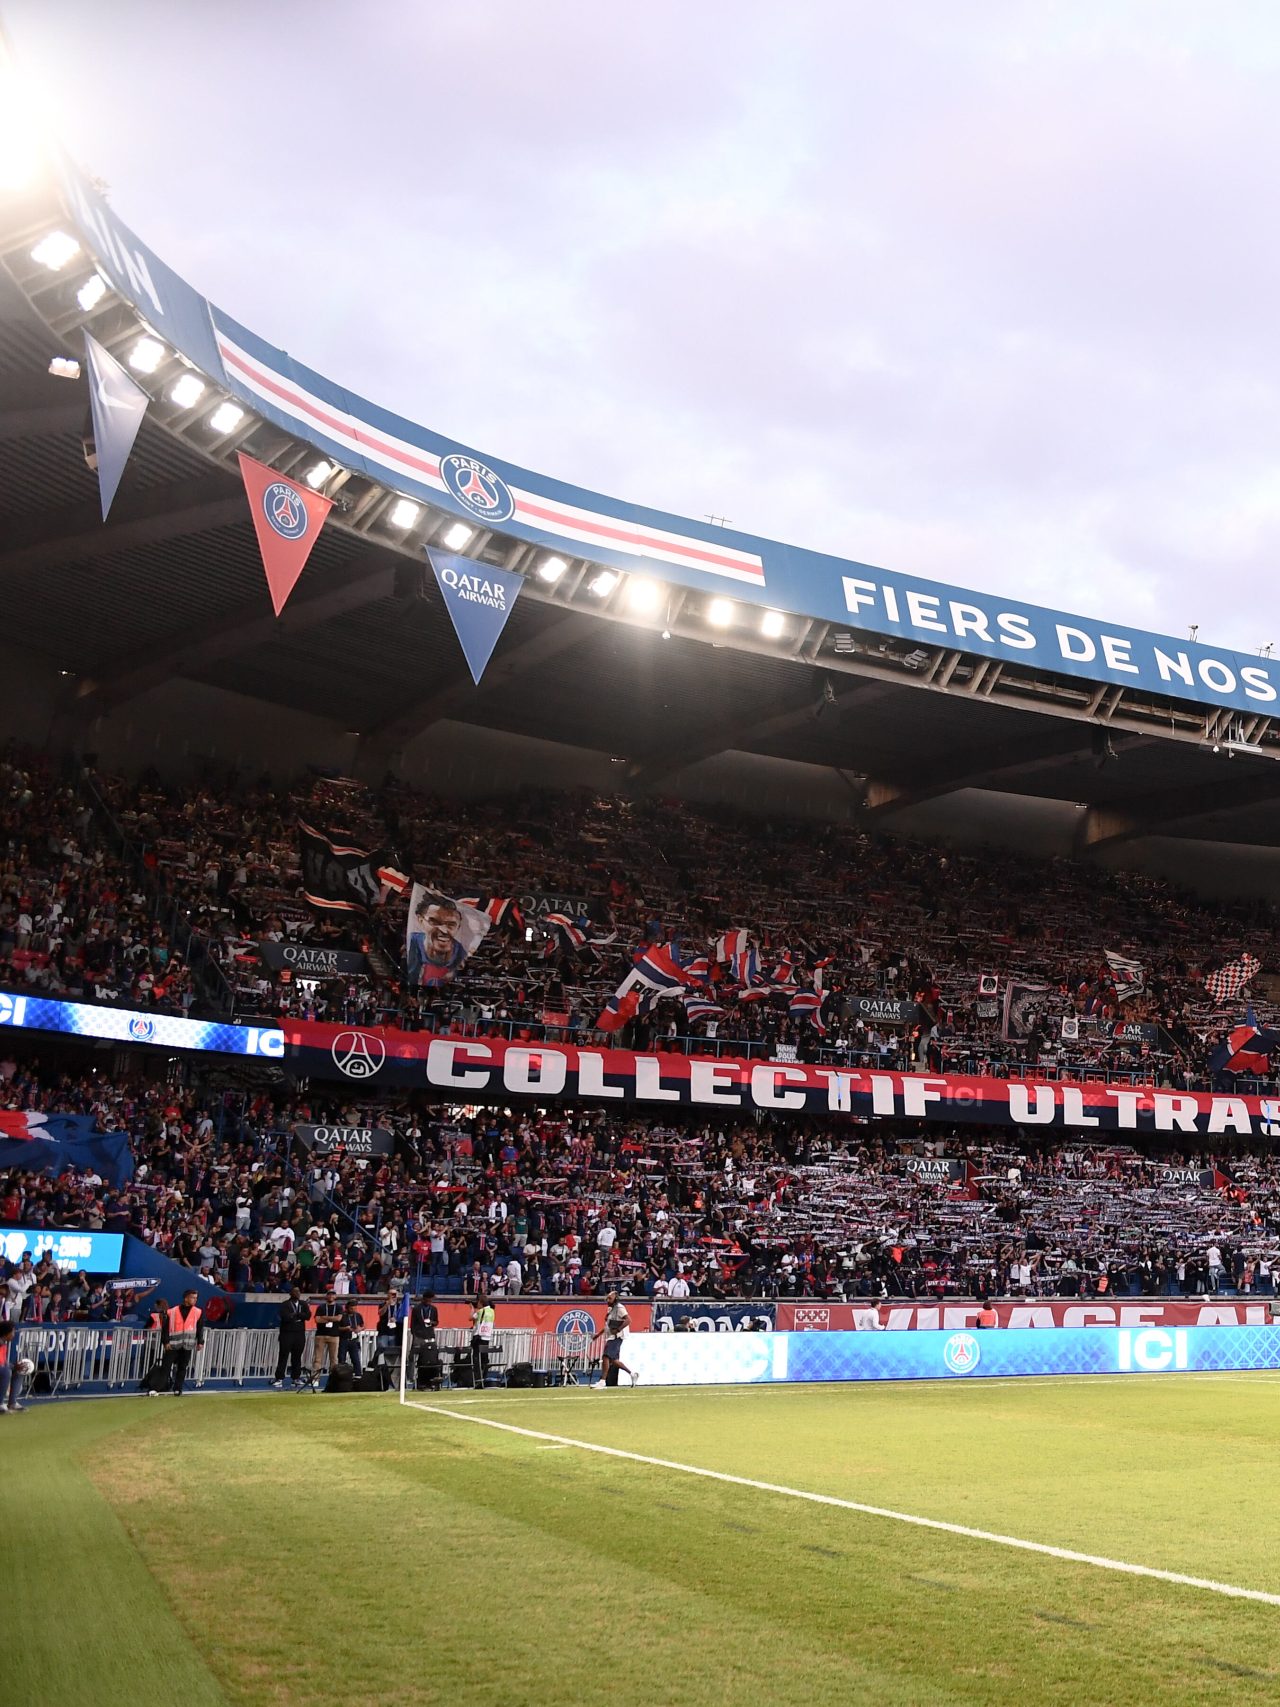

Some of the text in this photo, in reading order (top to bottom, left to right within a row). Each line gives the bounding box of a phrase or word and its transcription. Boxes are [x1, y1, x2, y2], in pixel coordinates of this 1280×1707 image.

[450, 457, 498, 485] PARIS
[272, 486, 301, 506] PARIS
[441, 568, 506, 601] QATAR
[458, 588, 506, 611] AIRWAYS
[841, 575, 1037, 650] FIERS
[1055, 623, 1139, 674] DE
[1153, 645, 1277, 702] NOS
[519, 895, 589, 916] QATAR
[283, 947, 338, 966] QATAR
[860, 999, 901, 1013] QATAR
[870, 1011, 901, 1020] AIRWAYS
[426, 1038, 948, 1117] COLLECTIF
[314, 1127, 372, 1144] QATAR
[906, 1160, 950, 1173] QATAR
[1163, 1170, 1201, 1181] QATAR
[563, 1312, 590, 1323] PARIS
[1118, 1330, 1188, 1370] ICI
